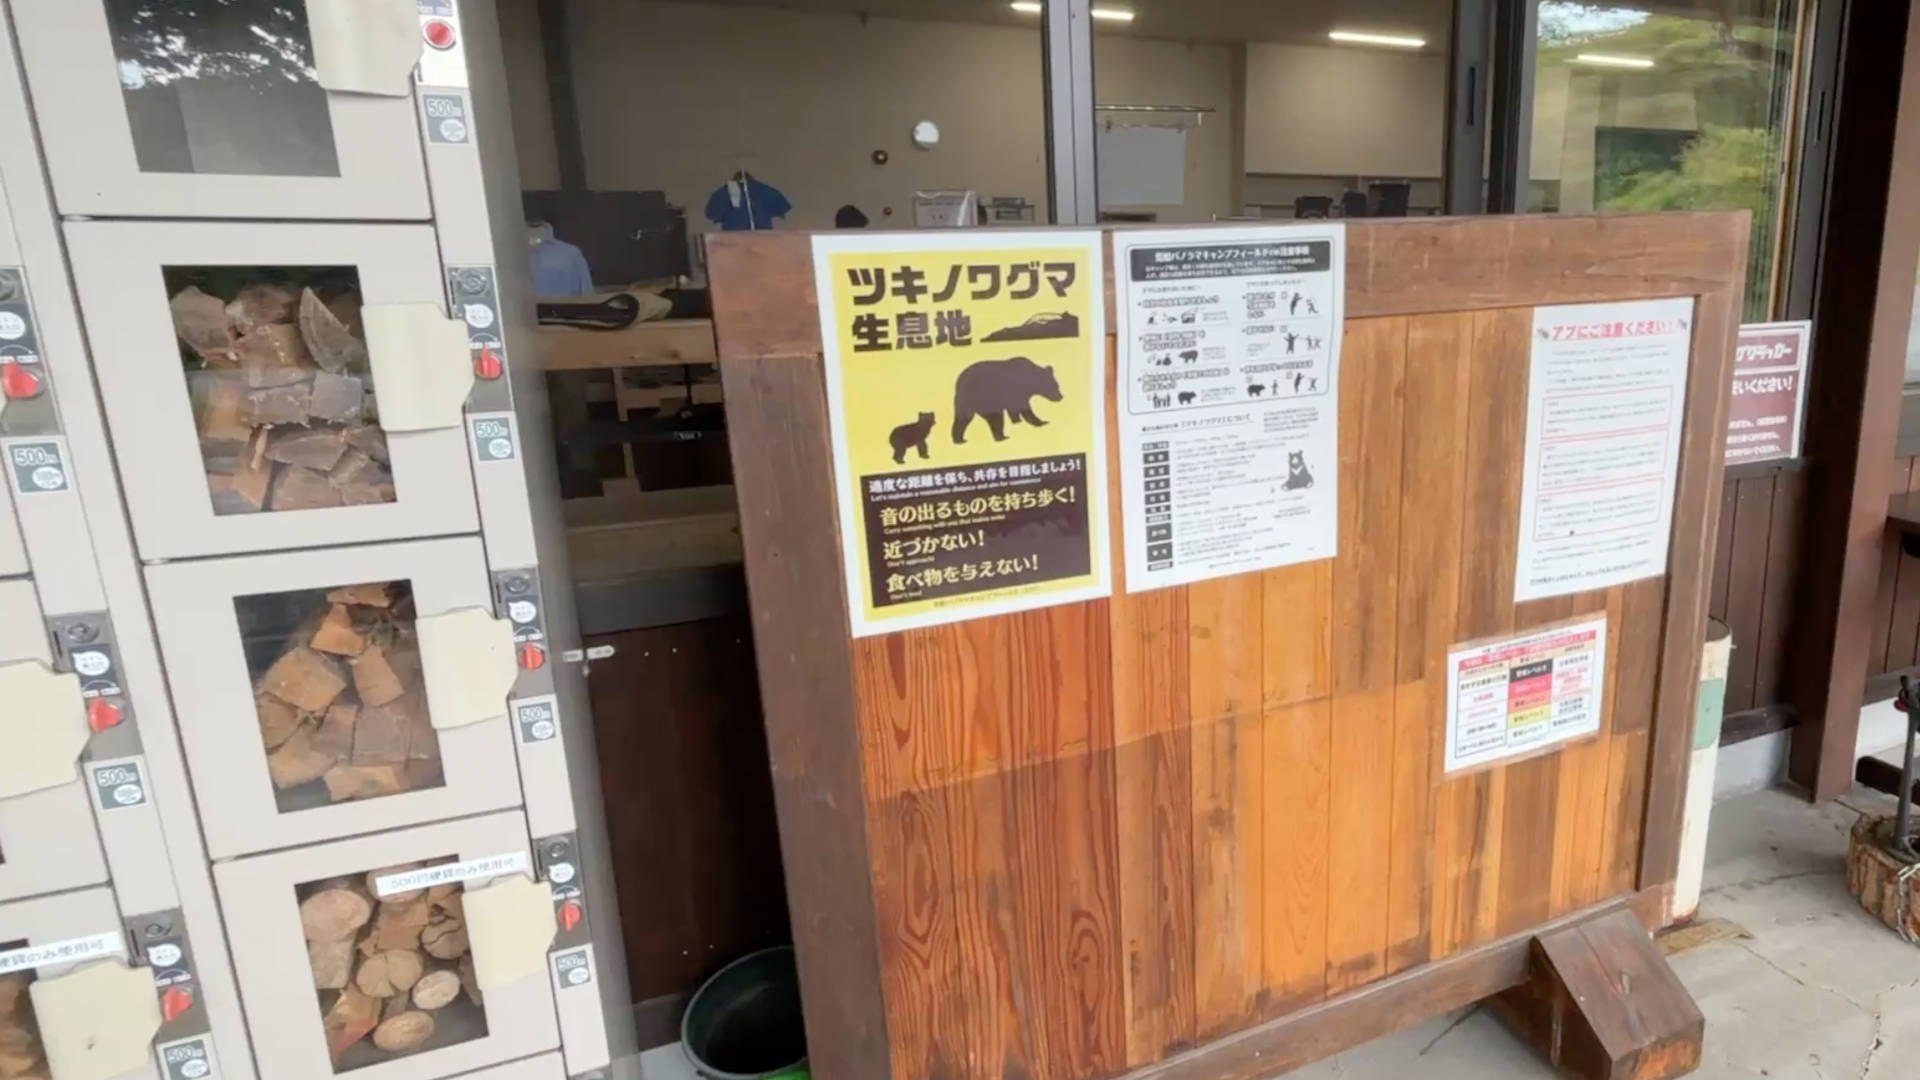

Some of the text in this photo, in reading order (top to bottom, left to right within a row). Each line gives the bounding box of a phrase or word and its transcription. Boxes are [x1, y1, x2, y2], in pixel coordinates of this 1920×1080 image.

[847, 261, 1076, 305] ツキノワグマ
[852, 309, 972, 352] 生息地
[14, 446, 45, 466] 500
[868, 459, 1082, 495] 適度な距離を保ち、共存を目指しましょう!
[880, 486, 1076, 527] 音の出るものを持ち歩く!
[883, 529, 985, 560] 近づかない!
[886, 553, 1039, 592] 食べ物を与えない!
